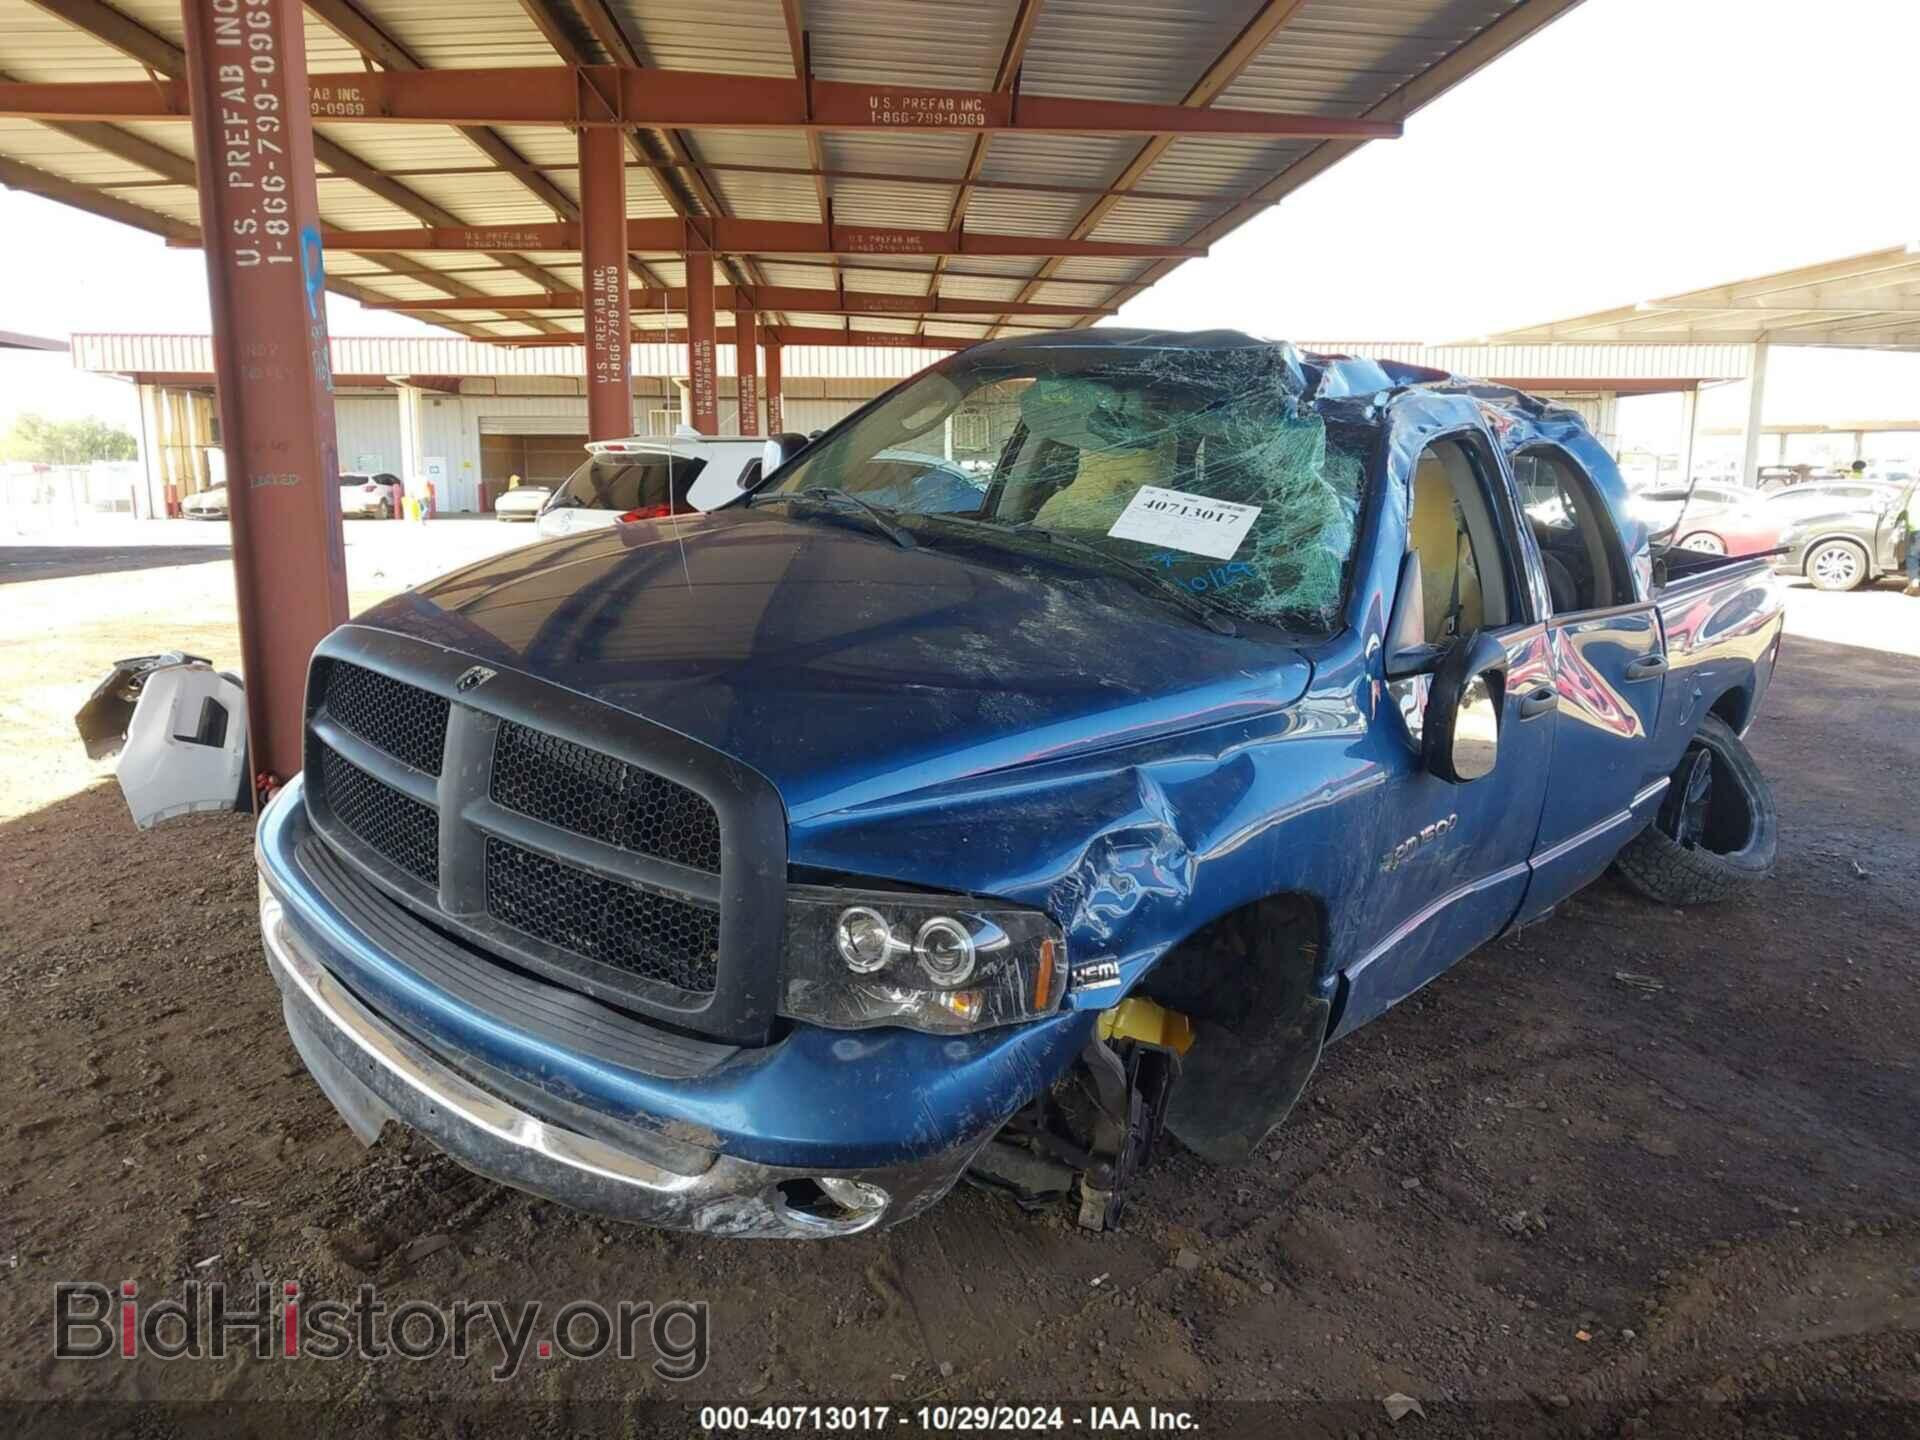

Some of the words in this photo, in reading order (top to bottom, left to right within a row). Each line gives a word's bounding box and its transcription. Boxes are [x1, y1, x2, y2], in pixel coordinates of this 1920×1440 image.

[902, 97, 954, 110] PREFAB
[960, 98, 986, 112] INC.
[218, 64, 255, 189] PREFAB
[233, 209, 262, 267] U.S.
[593, 297, 607, 350] PREFAB
[1143, 498, 1239, 525] 40713017
[1072, 960, 1120, 985] HEMI
